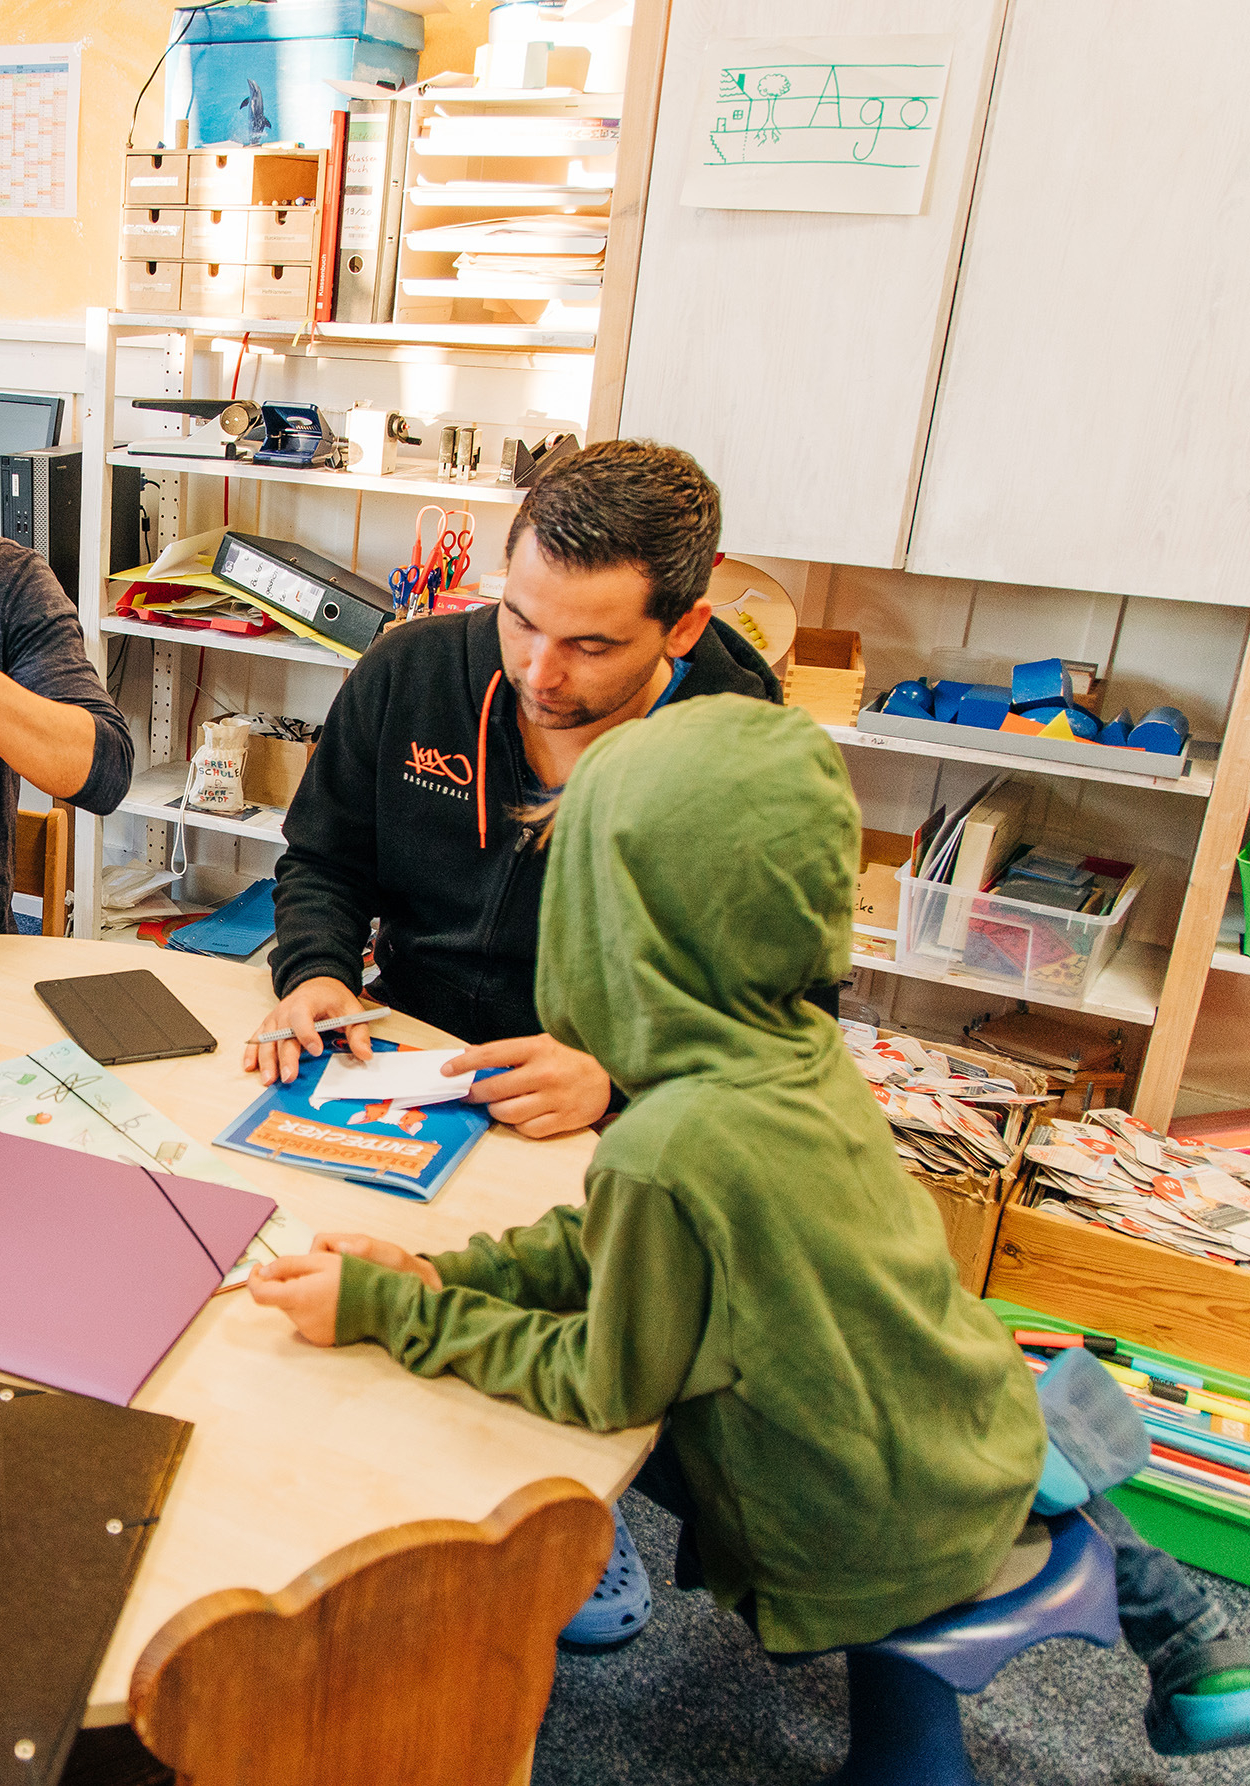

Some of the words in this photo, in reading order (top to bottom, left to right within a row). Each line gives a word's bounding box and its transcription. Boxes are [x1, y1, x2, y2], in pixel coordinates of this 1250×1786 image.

[318, 254, 327, 296] Klassenbuch
[199, 767, 240, 779] SCHULE
[403, 772, 469, 801] BASKETBALL
[200, 795, 229, 803] STADT
[278, 1119, 424, 1156] ENTDECKER
